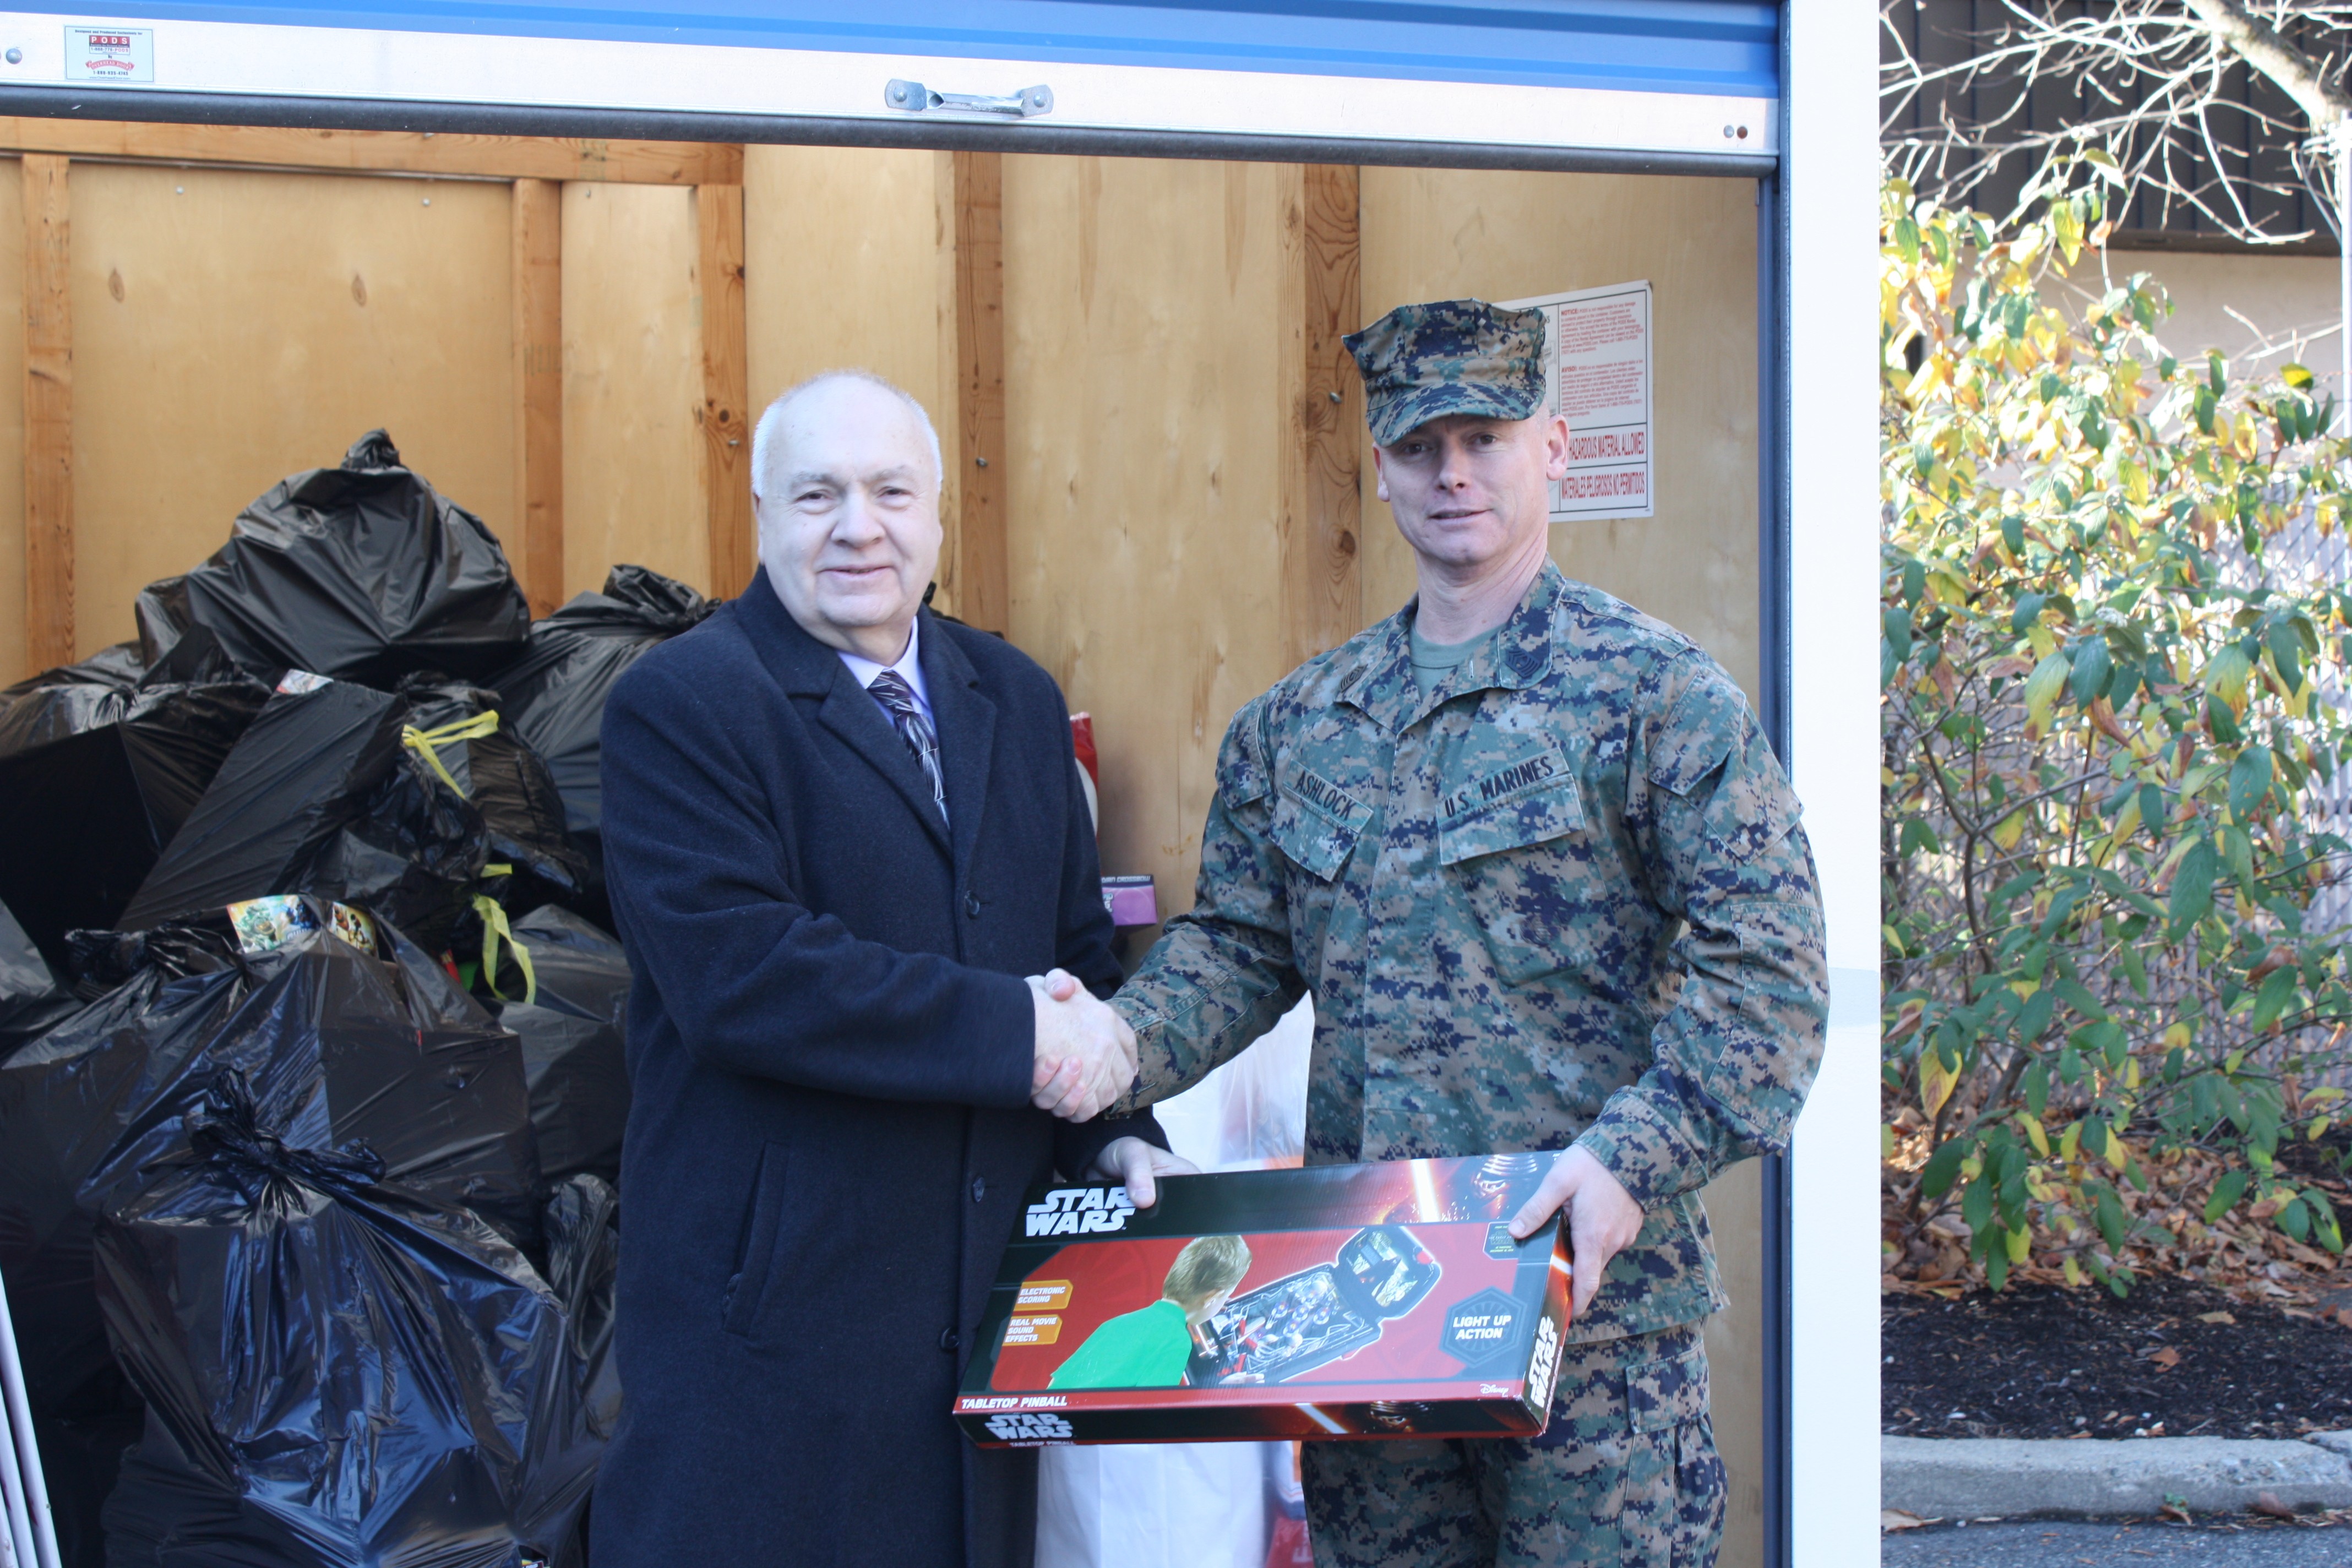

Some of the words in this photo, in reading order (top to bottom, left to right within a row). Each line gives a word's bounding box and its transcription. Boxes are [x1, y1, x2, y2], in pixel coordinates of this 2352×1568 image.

[91, 60, 115, 68] OVERHEAD
[1569, 436, 1597, 460] HAZARDOUS
[1598, 434, 1621, 459] MATERIAL
[1622, 432, 1645, 456] ALLOWED
[1561, 476, 1586, 499] MATERIALES
[1587, 473, 1613, 498] PELIGROSOS
[1613, 473, 1619, 496] NO
[1620, 471, 1645, 495] PERMITIDOS
[1444, 792, 1475, 818] U.S.
[1478, 755, 1555, 801] MARINES
[1295, 771, 1355, 821] ASHLOCK
[1027, 1186, 1135, 1214] STAR
[1026, 1207, 1136, 1237] WARS
[1020, 1287, 1066, 1295] ELECTRONIC
[1017, 1295, 1051, 1304] SCORING
[1010, 1319, 1031, 1327] REAL
[1031, 1317, 1058, 1325] MOVIE
[1452, 1315, 1491, 1327] LIGHT
[1493, 1315, 1512, 1326] UP
[1007, 1326, 1035, 1335] SOUND
[1455, 1327, 1504, 1340] ACTION
[1004, 1334, 1038, 1343] EFFECTS
[1529, 1315, 1552, 1402] STAR
[1534, 1321, 1558, 1408] WARS
[1479, 1383, 1509, 1398] Disney
[962, 1397, 1019, 1409] TABLETOP
[1020, 1396, 1068, 1408] PINBALL
[984, 1413, 1070, 1428] STAR
[989, 1425, 1074, 1440] WARS
